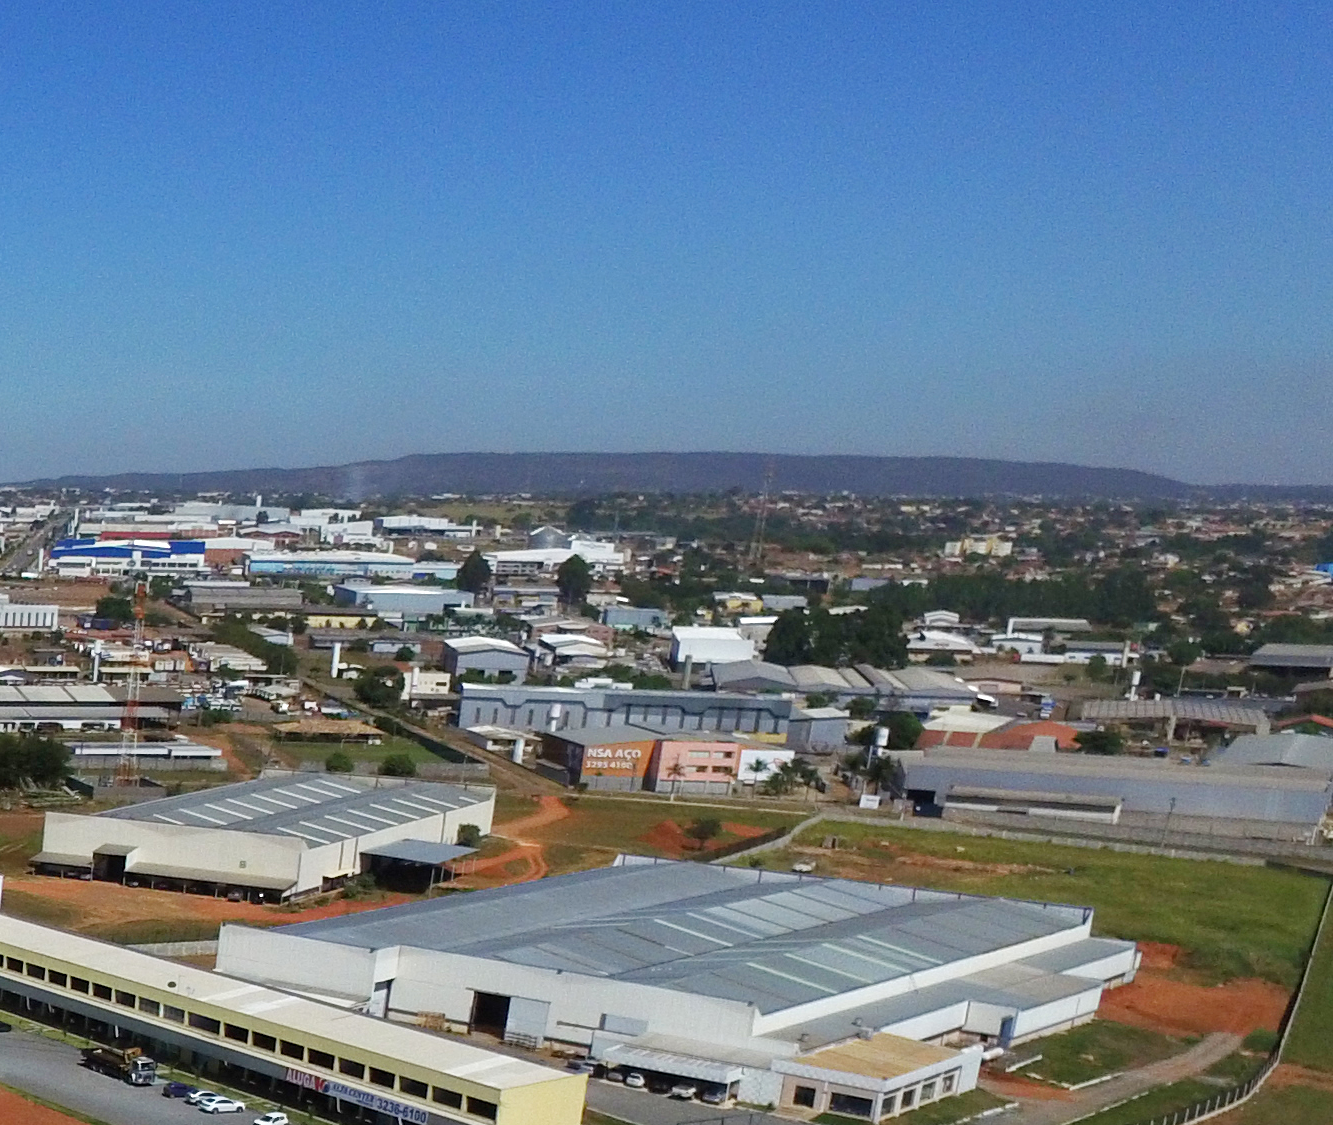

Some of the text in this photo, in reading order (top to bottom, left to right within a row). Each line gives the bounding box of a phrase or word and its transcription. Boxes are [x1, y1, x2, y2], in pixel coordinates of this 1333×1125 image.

[587, 748, 642, 760] NSA AÇO
[286, 1068, 316, 1089] ALUGA
